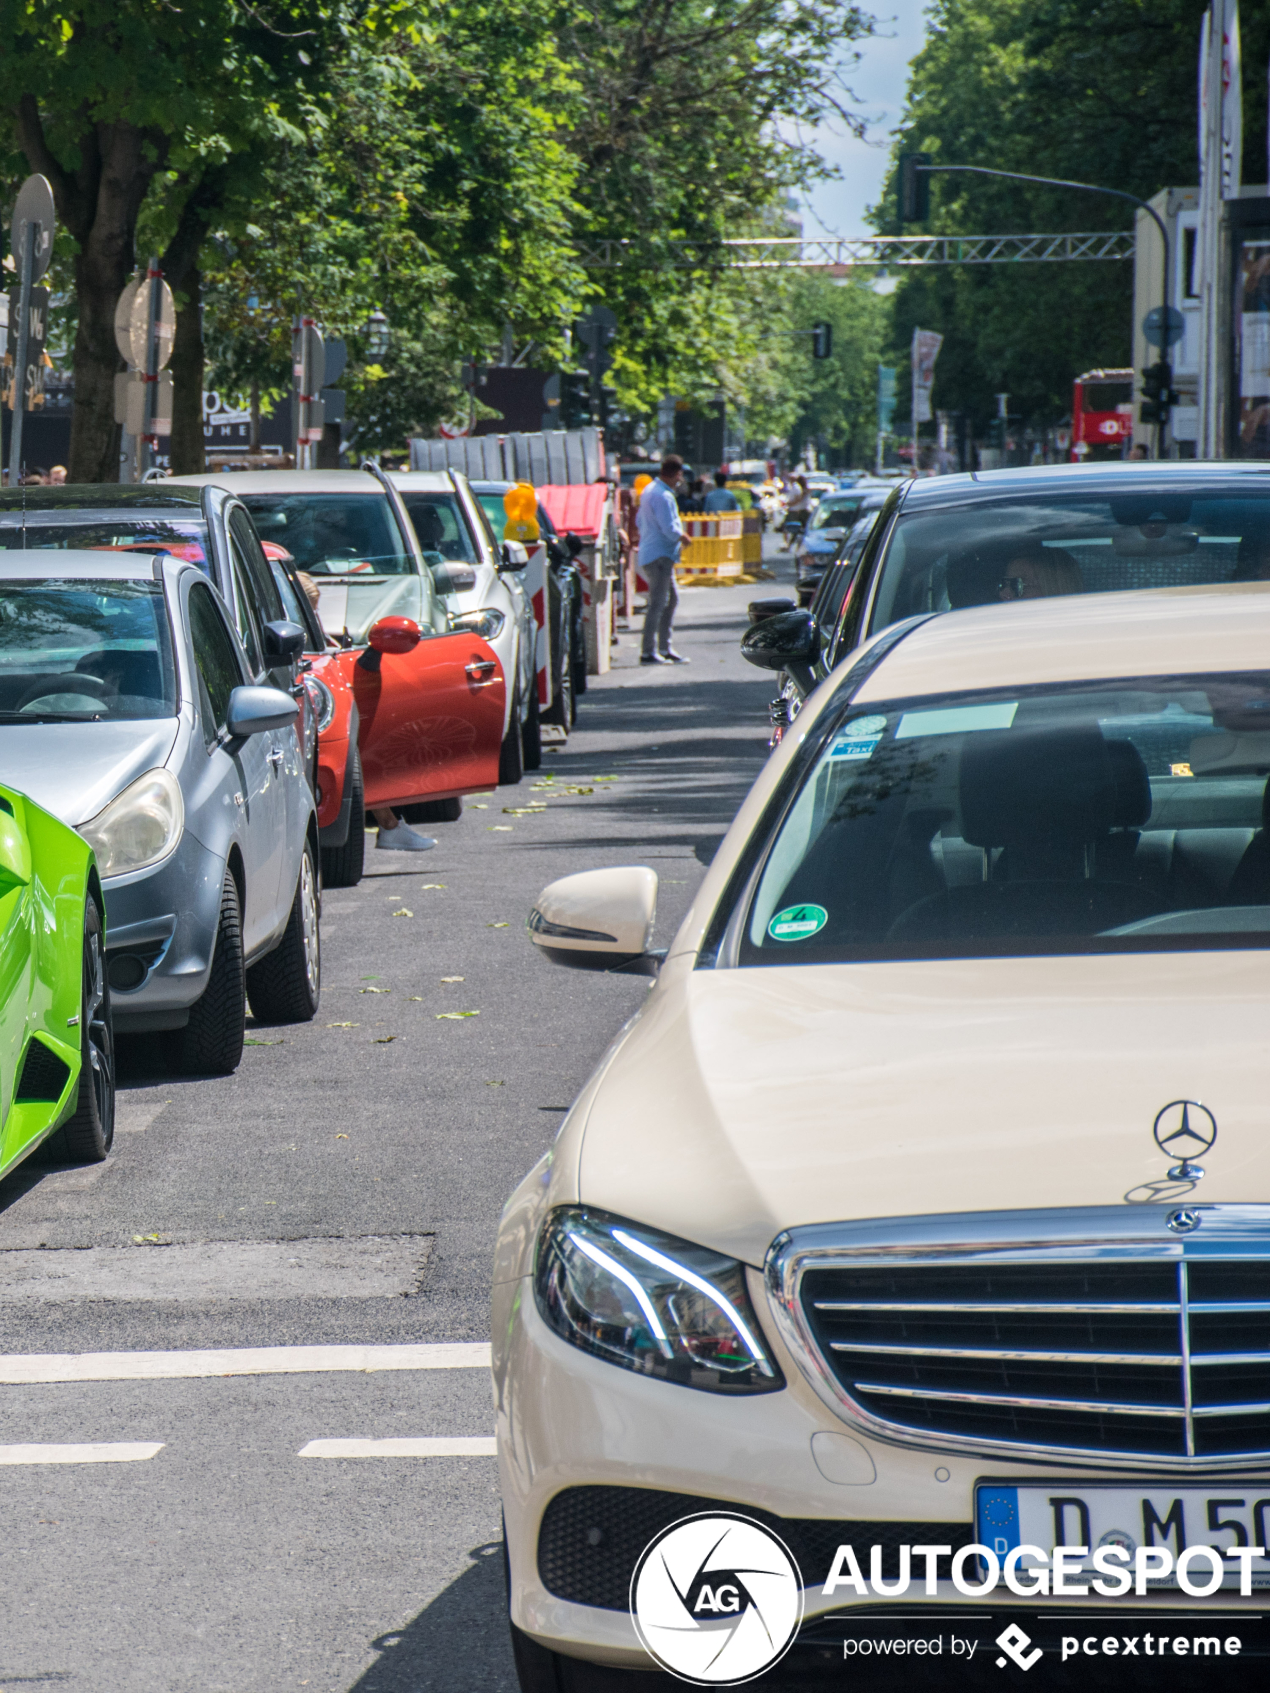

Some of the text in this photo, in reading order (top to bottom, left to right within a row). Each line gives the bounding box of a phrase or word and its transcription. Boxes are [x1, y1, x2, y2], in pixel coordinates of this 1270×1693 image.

[203, 425, 248, 436] UHE
[846, 744, 873, 755] Taxi
[792, 907, 807, 922] 4
[1049, 1497, 1092, 1560] D
[1141, 1498, 1186, 1561] M
[994, 1537, 1008, 1555] D
